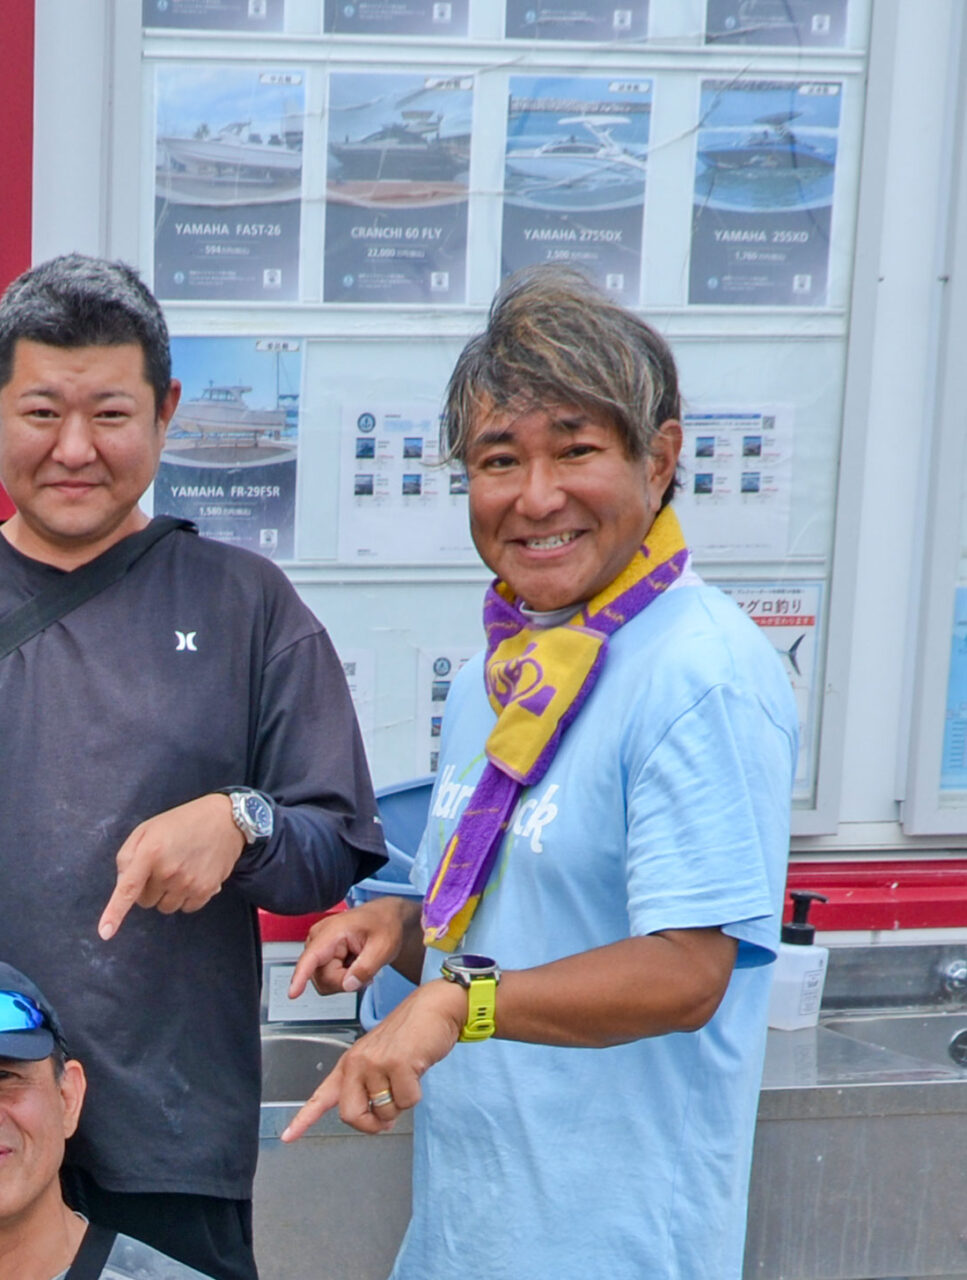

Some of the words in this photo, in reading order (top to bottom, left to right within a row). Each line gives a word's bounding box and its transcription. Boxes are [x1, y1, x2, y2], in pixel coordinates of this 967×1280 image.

[175, 223, 230, 236] YAMAHA
[351, 226, 402, 239] CRANCHI
[405, 227, 420, 239] 60
[422, 227, 443, 239] FLY
[524, 229, 576, 241] YAMAHA
[714, 230, 767, 242] YAMAHA
[171, 486, 224, 497] YAMAHA
